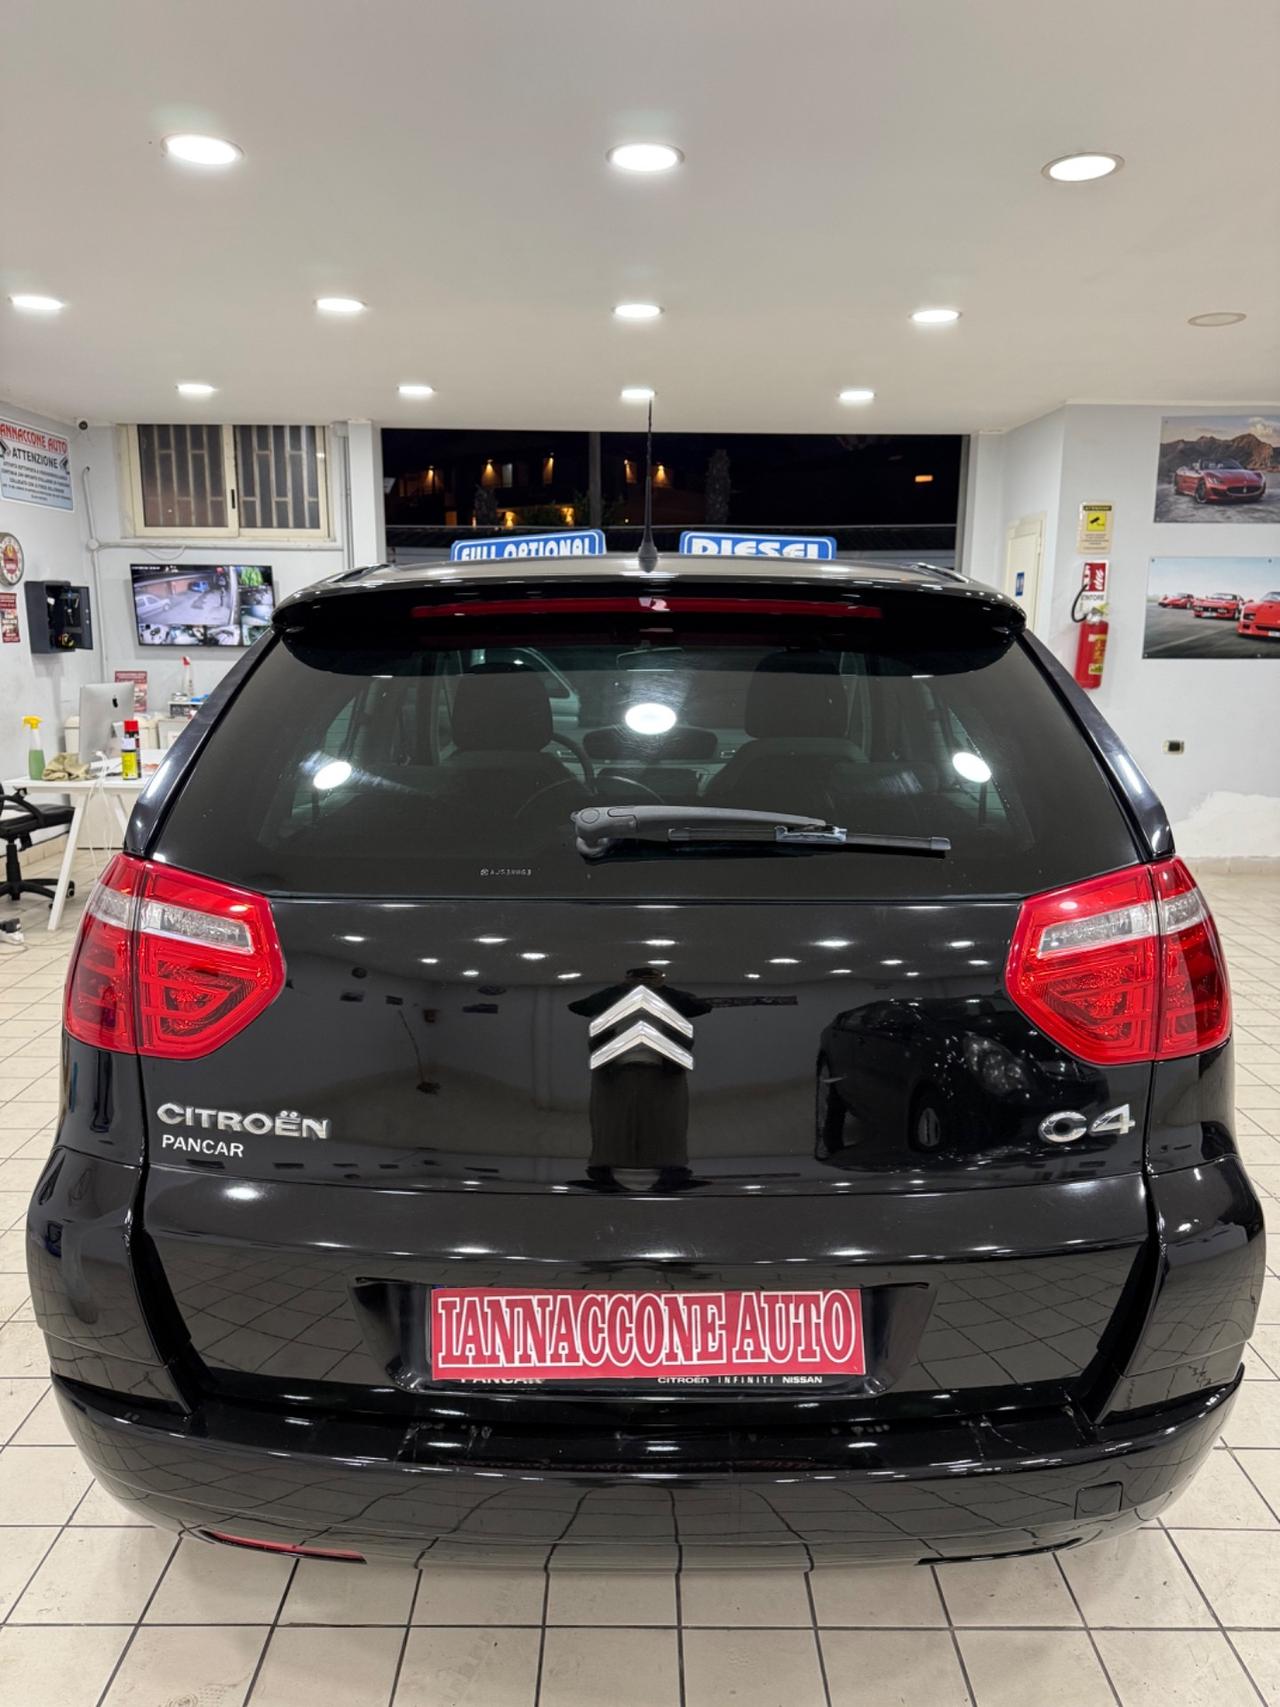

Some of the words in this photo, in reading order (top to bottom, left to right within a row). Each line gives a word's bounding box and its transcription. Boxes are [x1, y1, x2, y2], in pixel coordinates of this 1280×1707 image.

[47, 437, 69, 454] AUTO
[12, 447, 59, 469] ATTENZIONE
[156, 1102, 331, 1139] CITROËN
[1039, 1103, 1136, 1143] C4
[161, 1134, 245, 1158] PANCAR
[437, 1292, 727, 1369] IANNACCONE
[732, 1289, 856, 1364] AUTO
[718, 1376, 774, 1384] INFINITI
[782, 1376, 823, 1384] NISSAN
